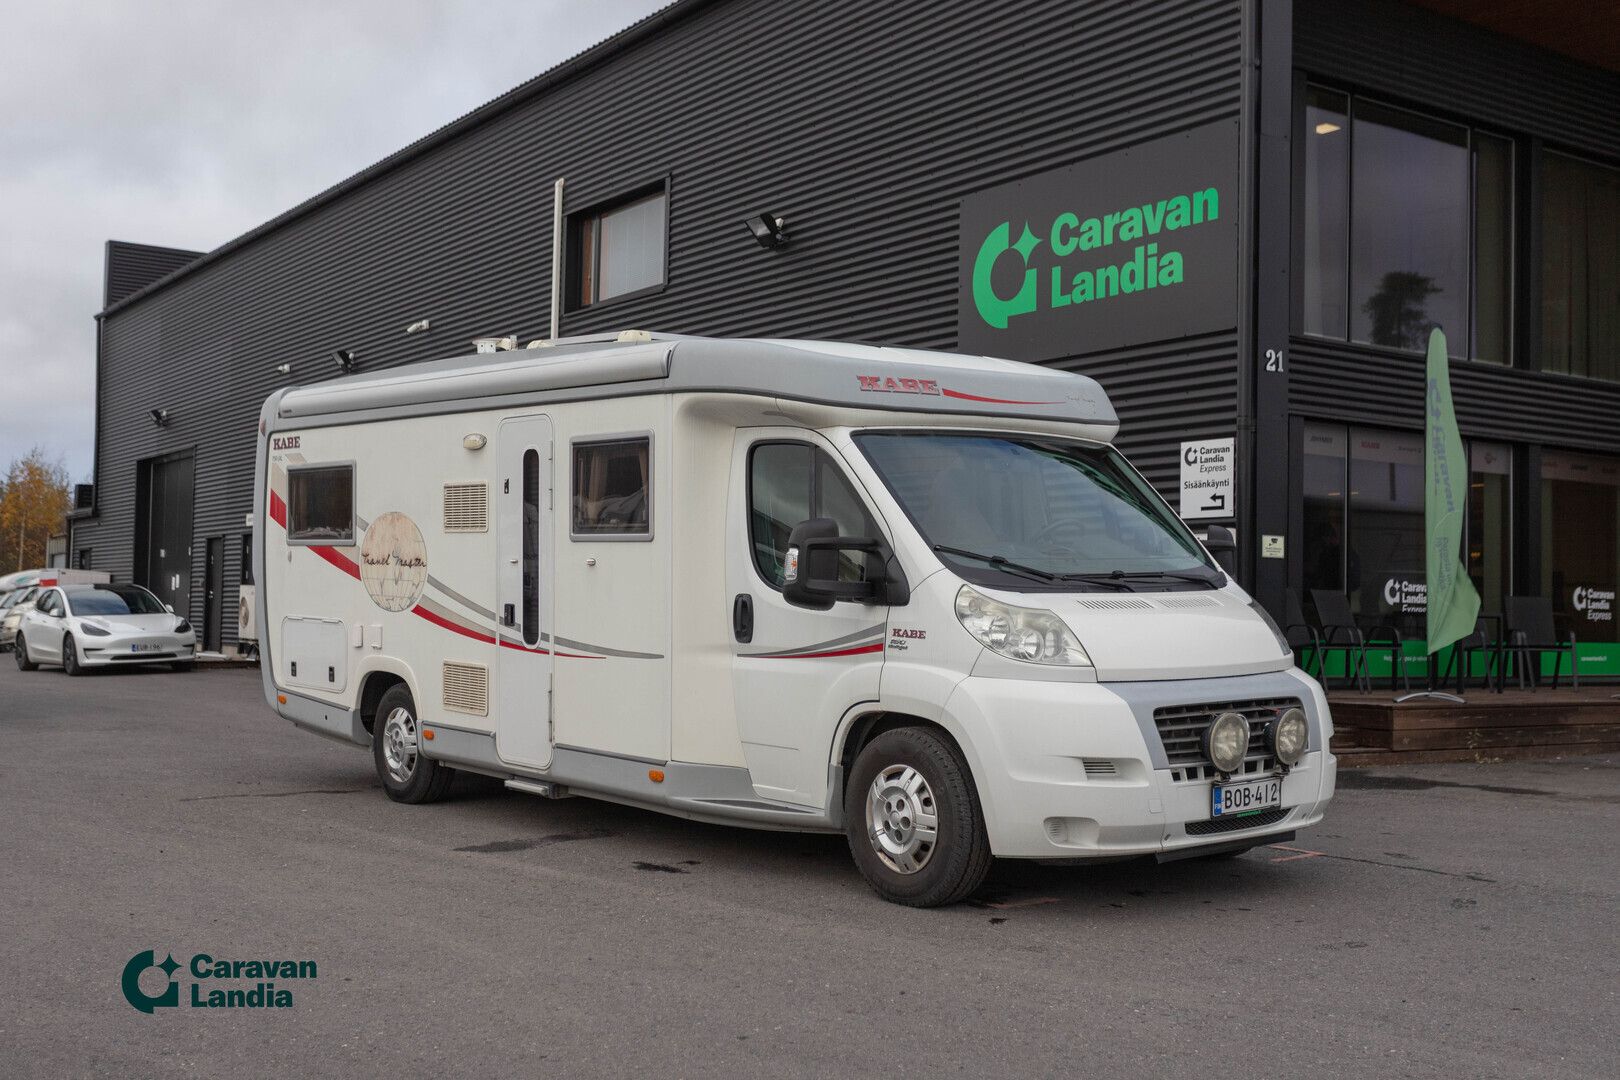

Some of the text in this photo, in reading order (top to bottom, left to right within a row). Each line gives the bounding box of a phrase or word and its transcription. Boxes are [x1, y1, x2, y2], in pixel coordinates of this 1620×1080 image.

[1050, 187, 1219, 256] Caravan
[1051, 243, 1184, 308] Landia
[1265, 349, 1284, 372] 21
[856, 375, 940, 396] KABE
[273, 436, 300, 450] KABE
[1200, 446, 1230, 455] Caravan
[1200, 455, 1225, 464] Landia
[1200, 464, 1226, 473] Express
[1184, 478, 1230, 490] Sisäänkäynti
[1402, 581, 1427, 592] Carav
[892, 628, 926, 639] KABE
[1224, 783, 1277, 809] BOB-412
